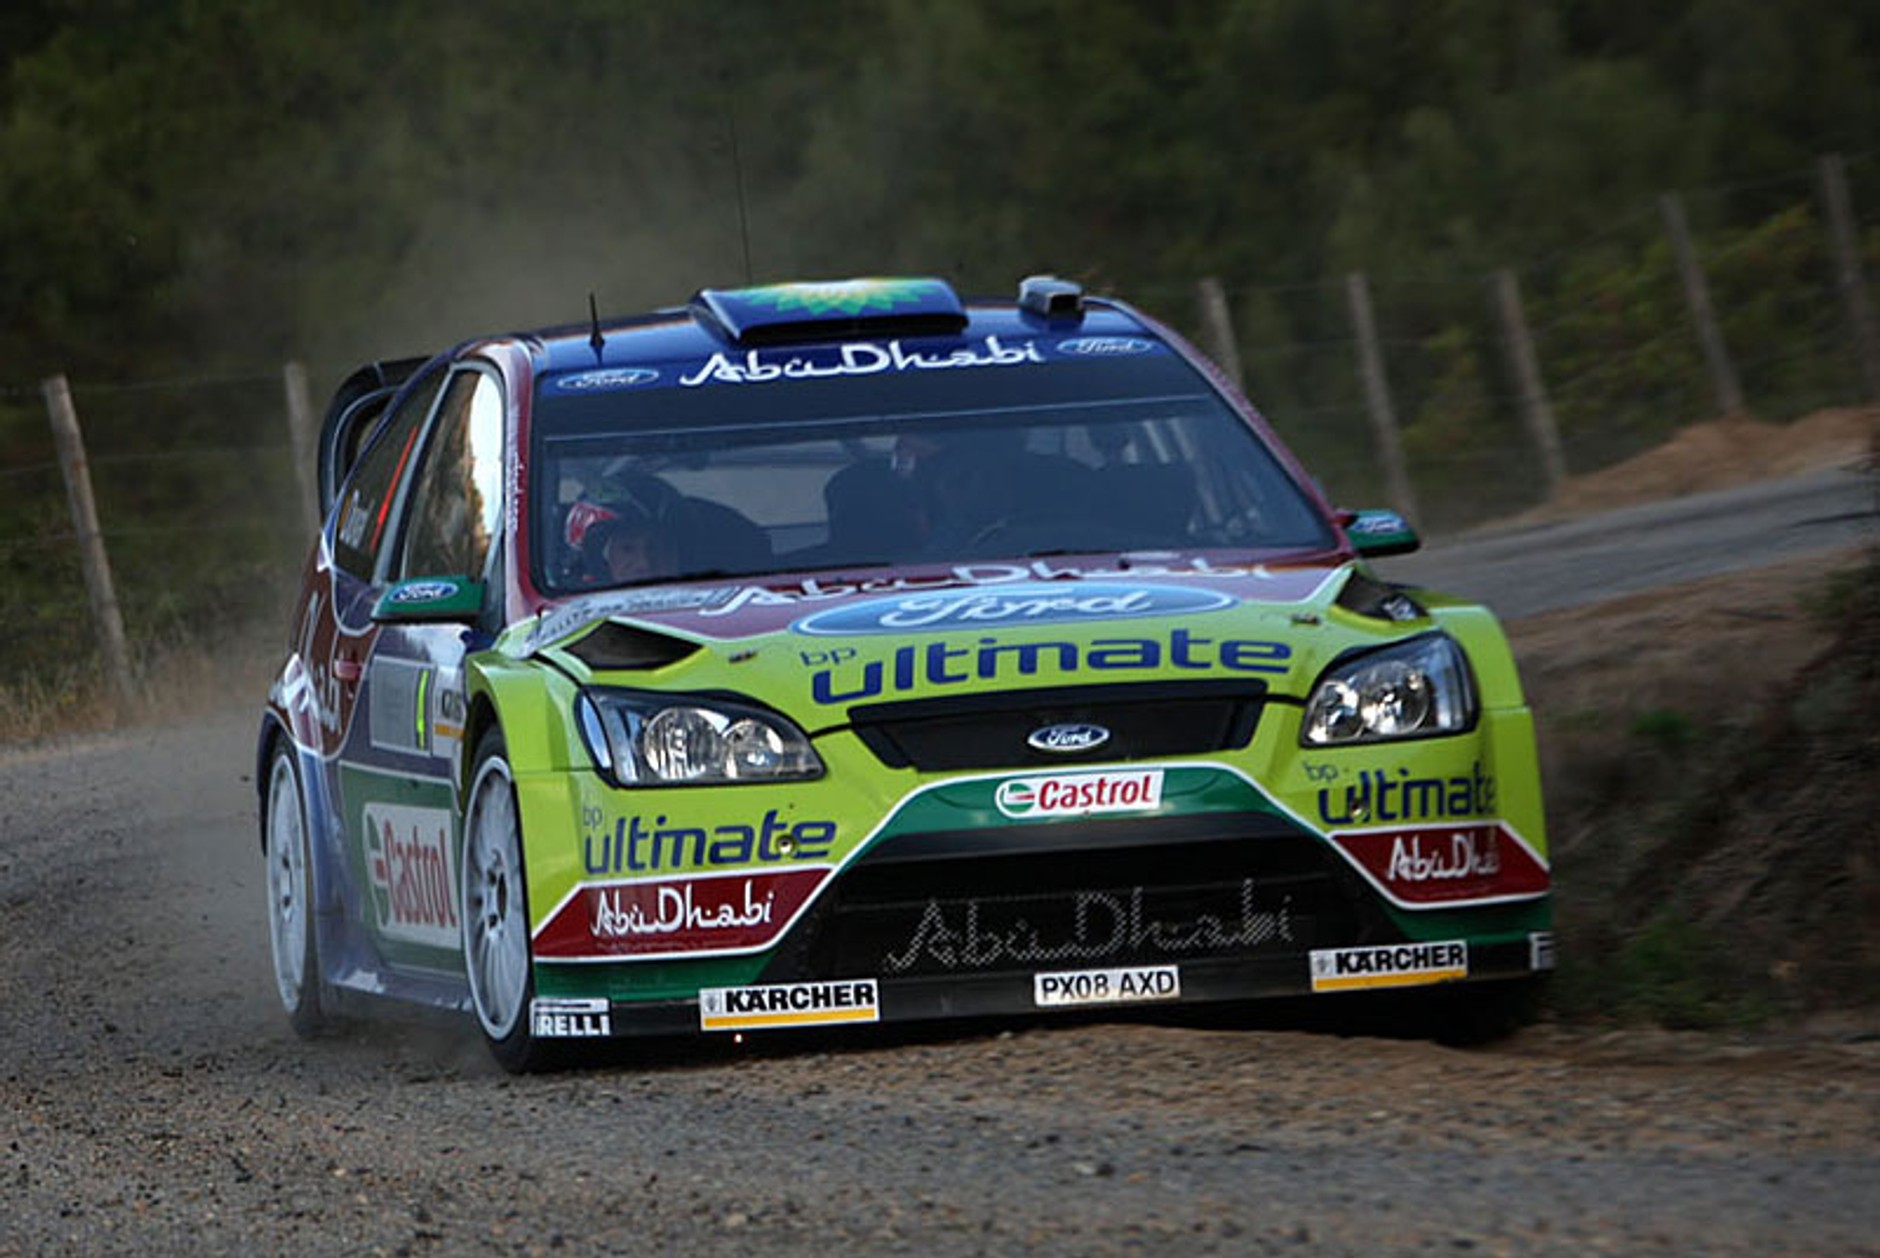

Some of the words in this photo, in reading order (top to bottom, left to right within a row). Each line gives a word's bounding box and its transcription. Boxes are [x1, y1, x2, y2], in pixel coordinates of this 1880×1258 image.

[880, 587, 1152, 628] Ford
[800, 646, 857, 669] bp
[811, 628, 1293, 706] ultimate
[1046, 724, 1094, 747] Ford
[1303, 761, 1339, 782] bp
[1038, 774, 1154, 812] Castrol
[582, 804, 603, 827] bp
[584, 808, 837, 875] ultimate
[383, 818, 457, 930] Castrol
[1041, 975, 1110, 999] PX08
[1119, 970, 1176, 997] AXD
